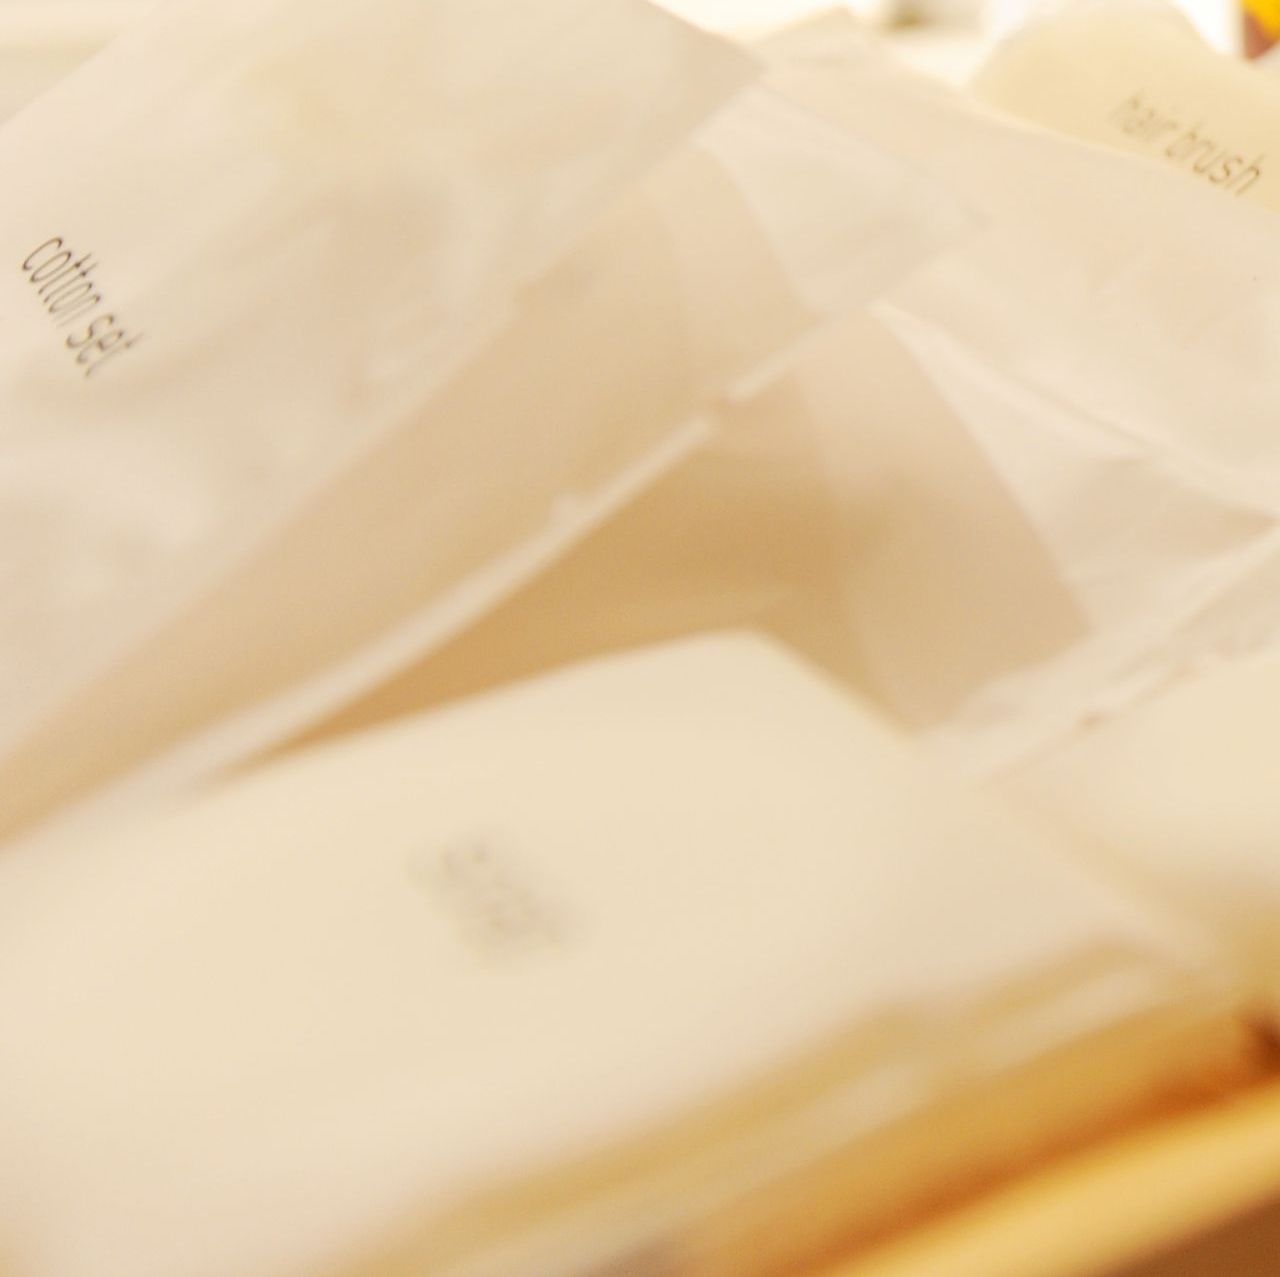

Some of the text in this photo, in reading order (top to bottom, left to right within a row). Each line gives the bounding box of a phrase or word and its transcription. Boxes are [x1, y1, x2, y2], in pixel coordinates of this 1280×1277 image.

[1164, 123, 1266, 197] brush
[21, 237, 144, 379] cotton set
